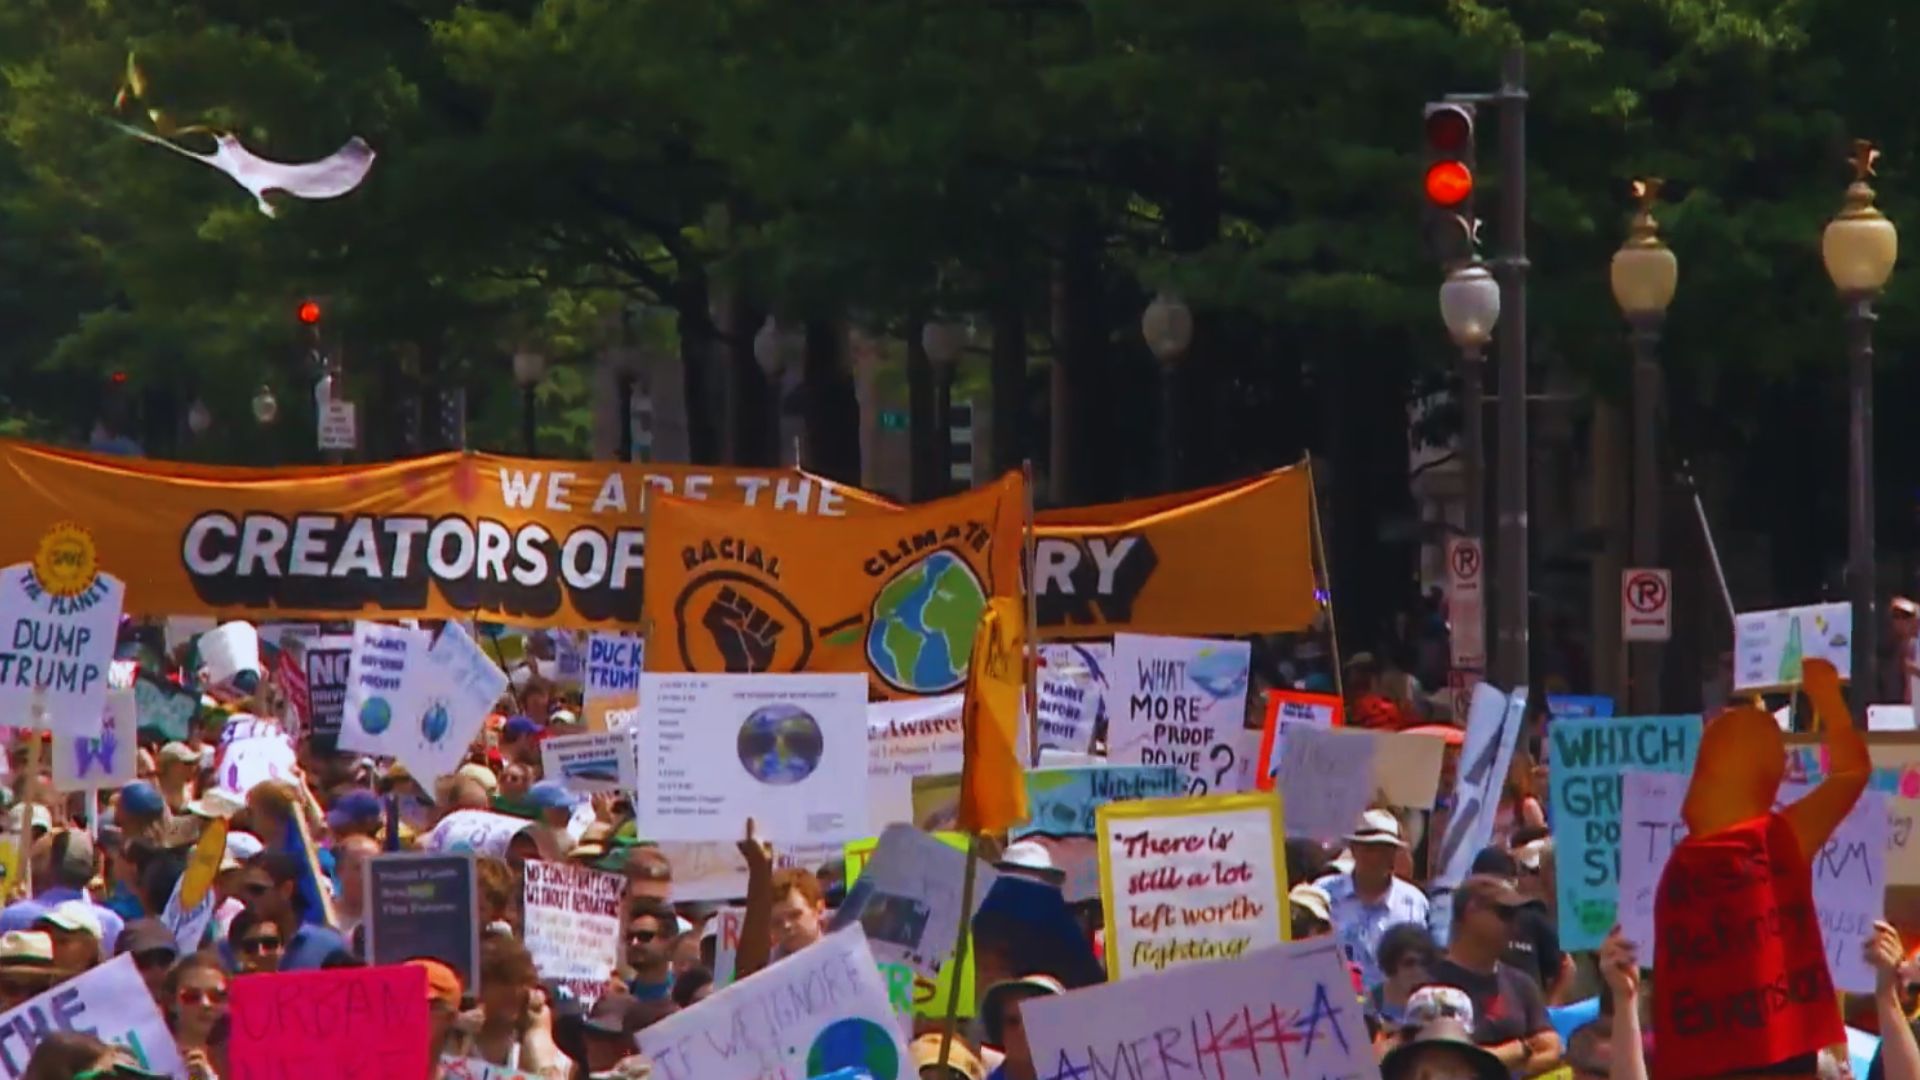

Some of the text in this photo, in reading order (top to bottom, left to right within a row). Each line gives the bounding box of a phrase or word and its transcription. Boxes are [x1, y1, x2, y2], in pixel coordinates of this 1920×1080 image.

[500, 467, 576, 511] WE
[735, 475, 847, 517] THE
[182, 513, 552, 588] CREATORS
[560, 525, 645, 592] OF
[681, 537, 781, 580] RACIAL
[863, 520, 993, 577] CLIMATE
[13, 618, 91, 657] DUMP
[0, 653, 100, 694] TRUMP
[589, 666, 640, 691] TRUM
[1137, 657, 1187, 693] WHAT
[1130, 694, 1202, 722] MORE
[1153, 724, 1214, 746] PROOF
[1554, 724, 1686, 769] WHICH
[1208, 827, 1234, 850] is
[1128, 862, 1253, 895] still a lot
[1129, 896, 1263, 932] left worth
